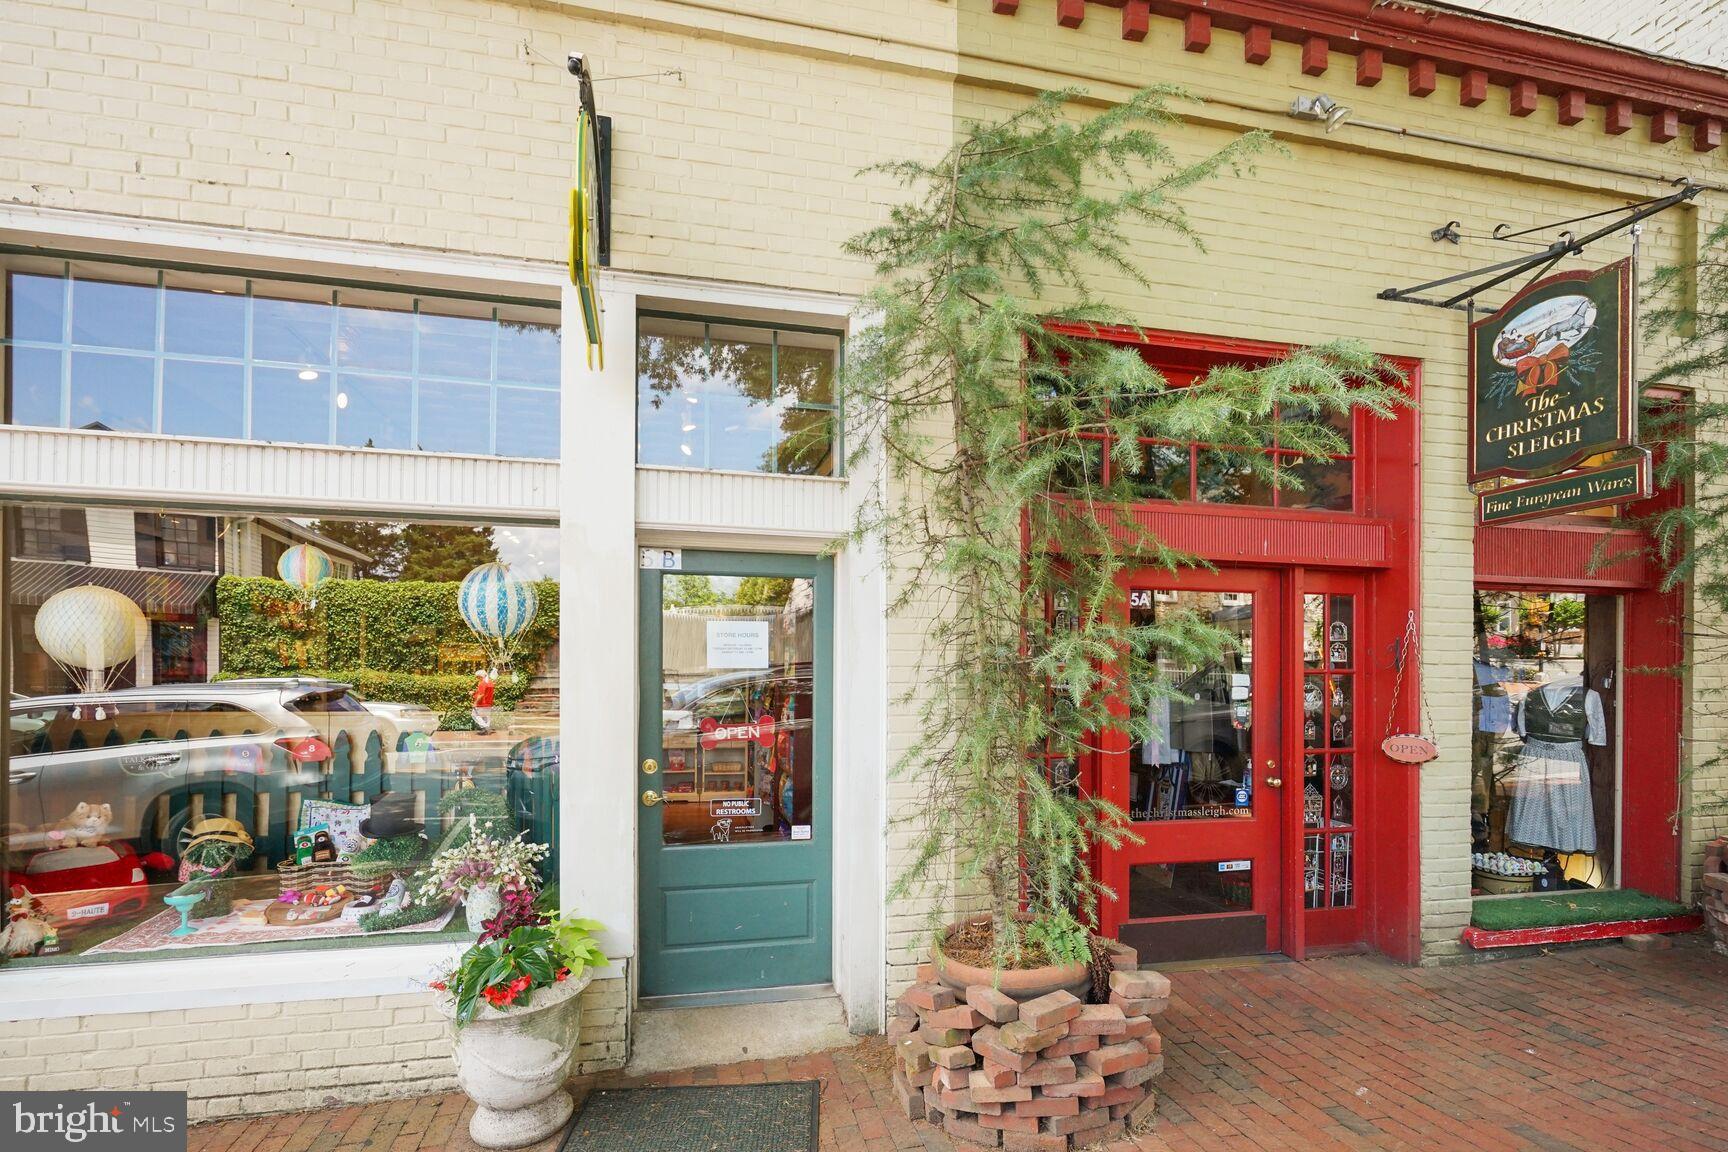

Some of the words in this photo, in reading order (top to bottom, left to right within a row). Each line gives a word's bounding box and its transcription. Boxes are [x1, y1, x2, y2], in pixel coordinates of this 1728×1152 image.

[1525, 390, 1570, 413] The
[1485, 397, 1604, 444] CHRISTMAS
[1507, 426, 1583, 459] SLEIGH
[1485, 494, 1512, 514] Fine
[1517, 487, 1582, 509] European
[1587, 475, 1634, 495] Wares
[1131, 592, 1150, 606] 5A
[715, 725, 761, 740] OPEN
[1390, 744, 1429, 755] OPEN
[1131, 805, 1249, 818] thechristmassleigh.com
